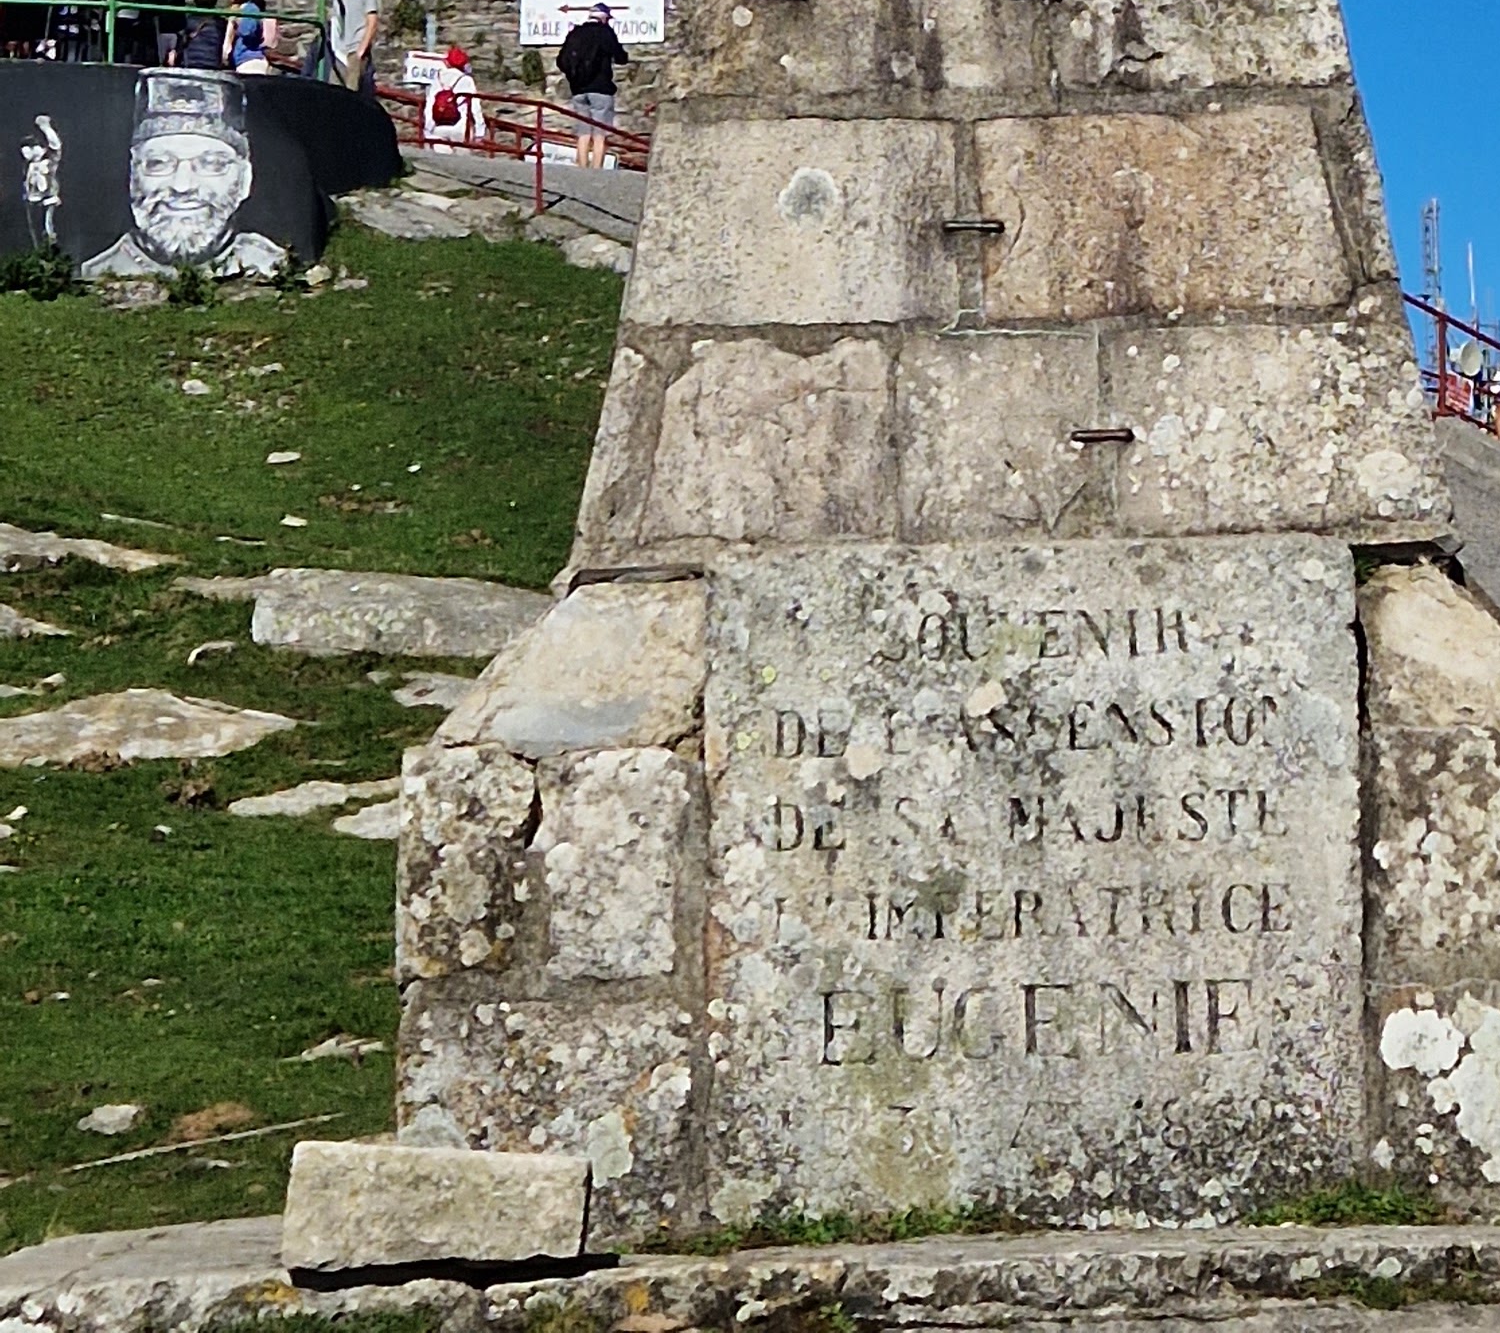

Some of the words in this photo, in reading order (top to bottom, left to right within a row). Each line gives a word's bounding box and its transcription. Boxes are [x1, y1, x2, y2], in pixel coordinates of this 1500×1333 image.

[527, 21, 560, 36] TABLE
[775, 710, 847, 758] DE
[770, 795, 847, 852] DE
